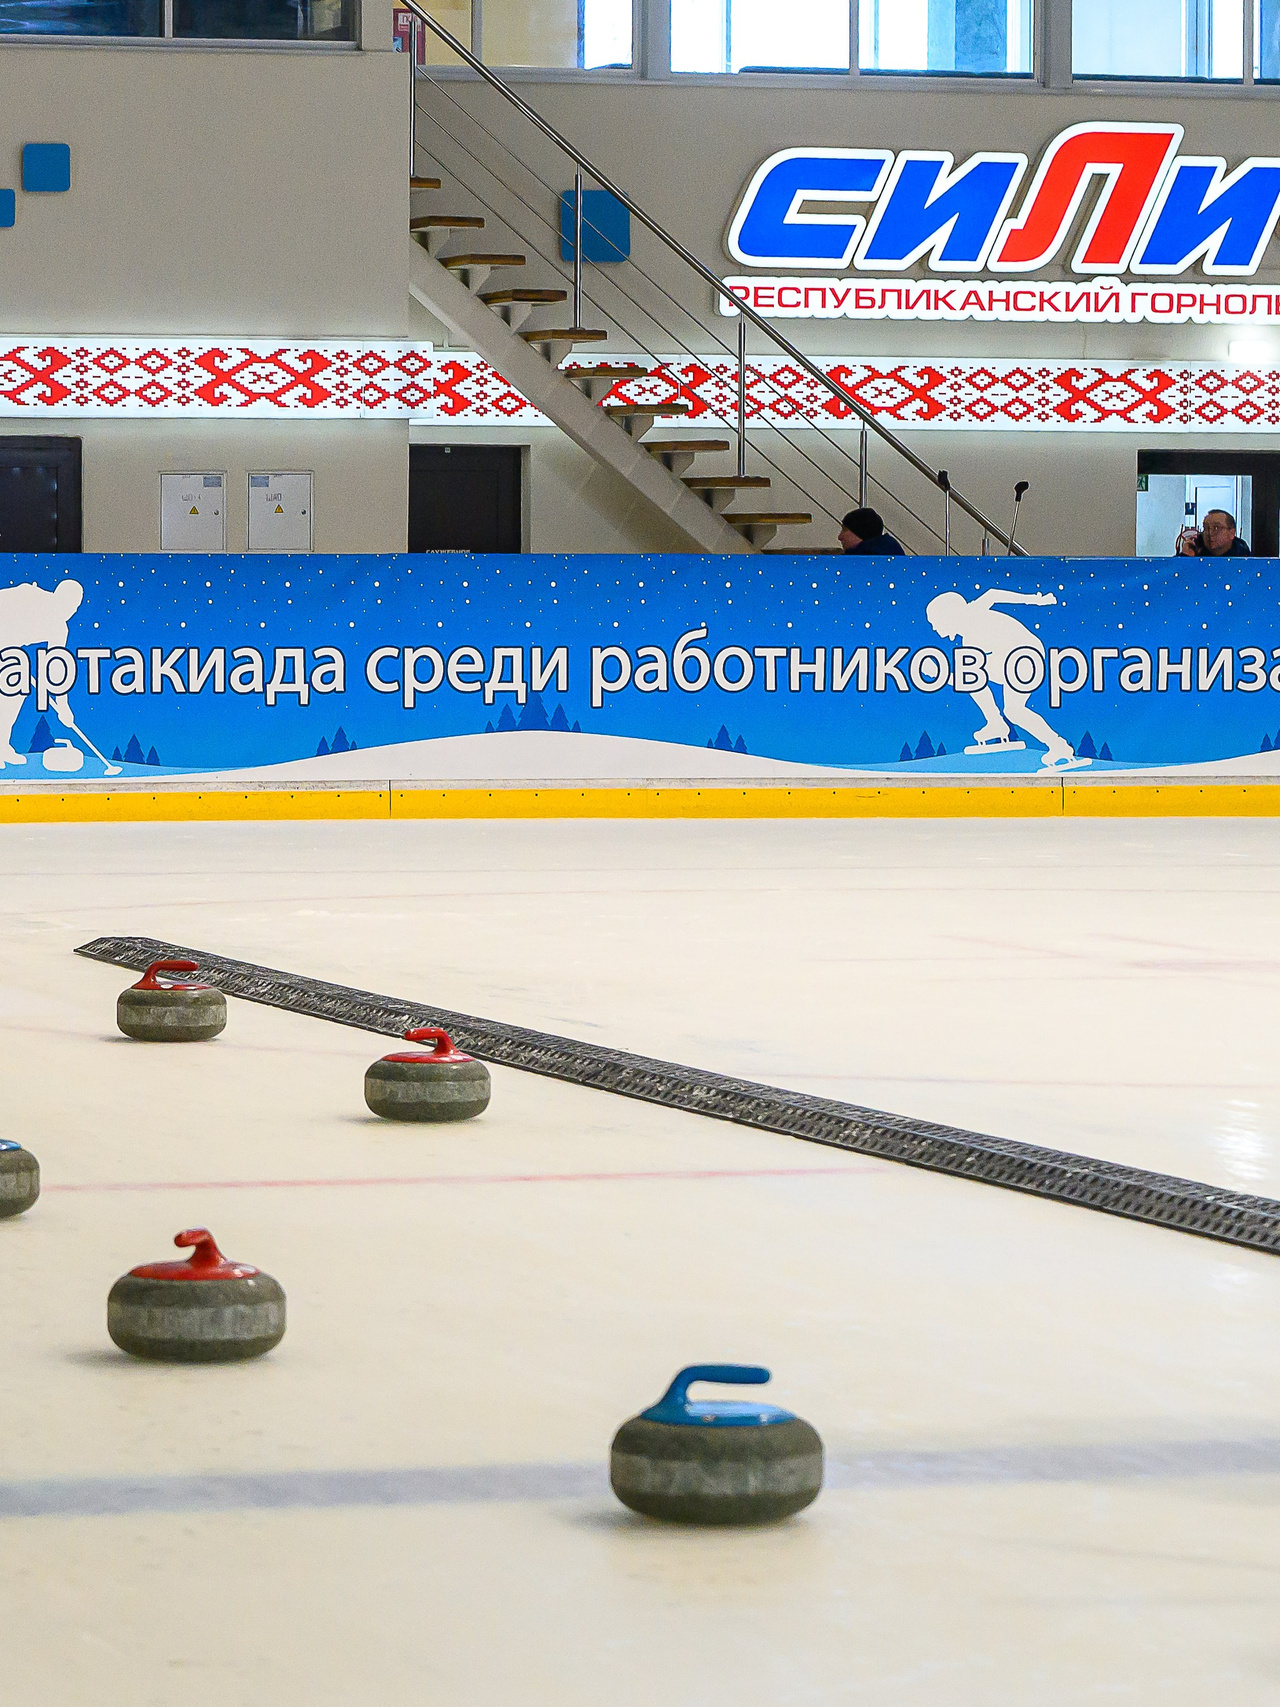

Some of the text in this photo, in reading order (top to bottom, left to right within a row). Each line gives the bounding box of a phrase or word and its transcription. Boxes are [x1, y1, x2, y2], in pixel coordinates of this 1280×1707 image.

[729, 284, 1280, 315] РЕСПУБЛИКАНСКИЙ ГОРНОЛ
[365, 644, 570, 710] среди
[589, 628, 988, 709] работников
